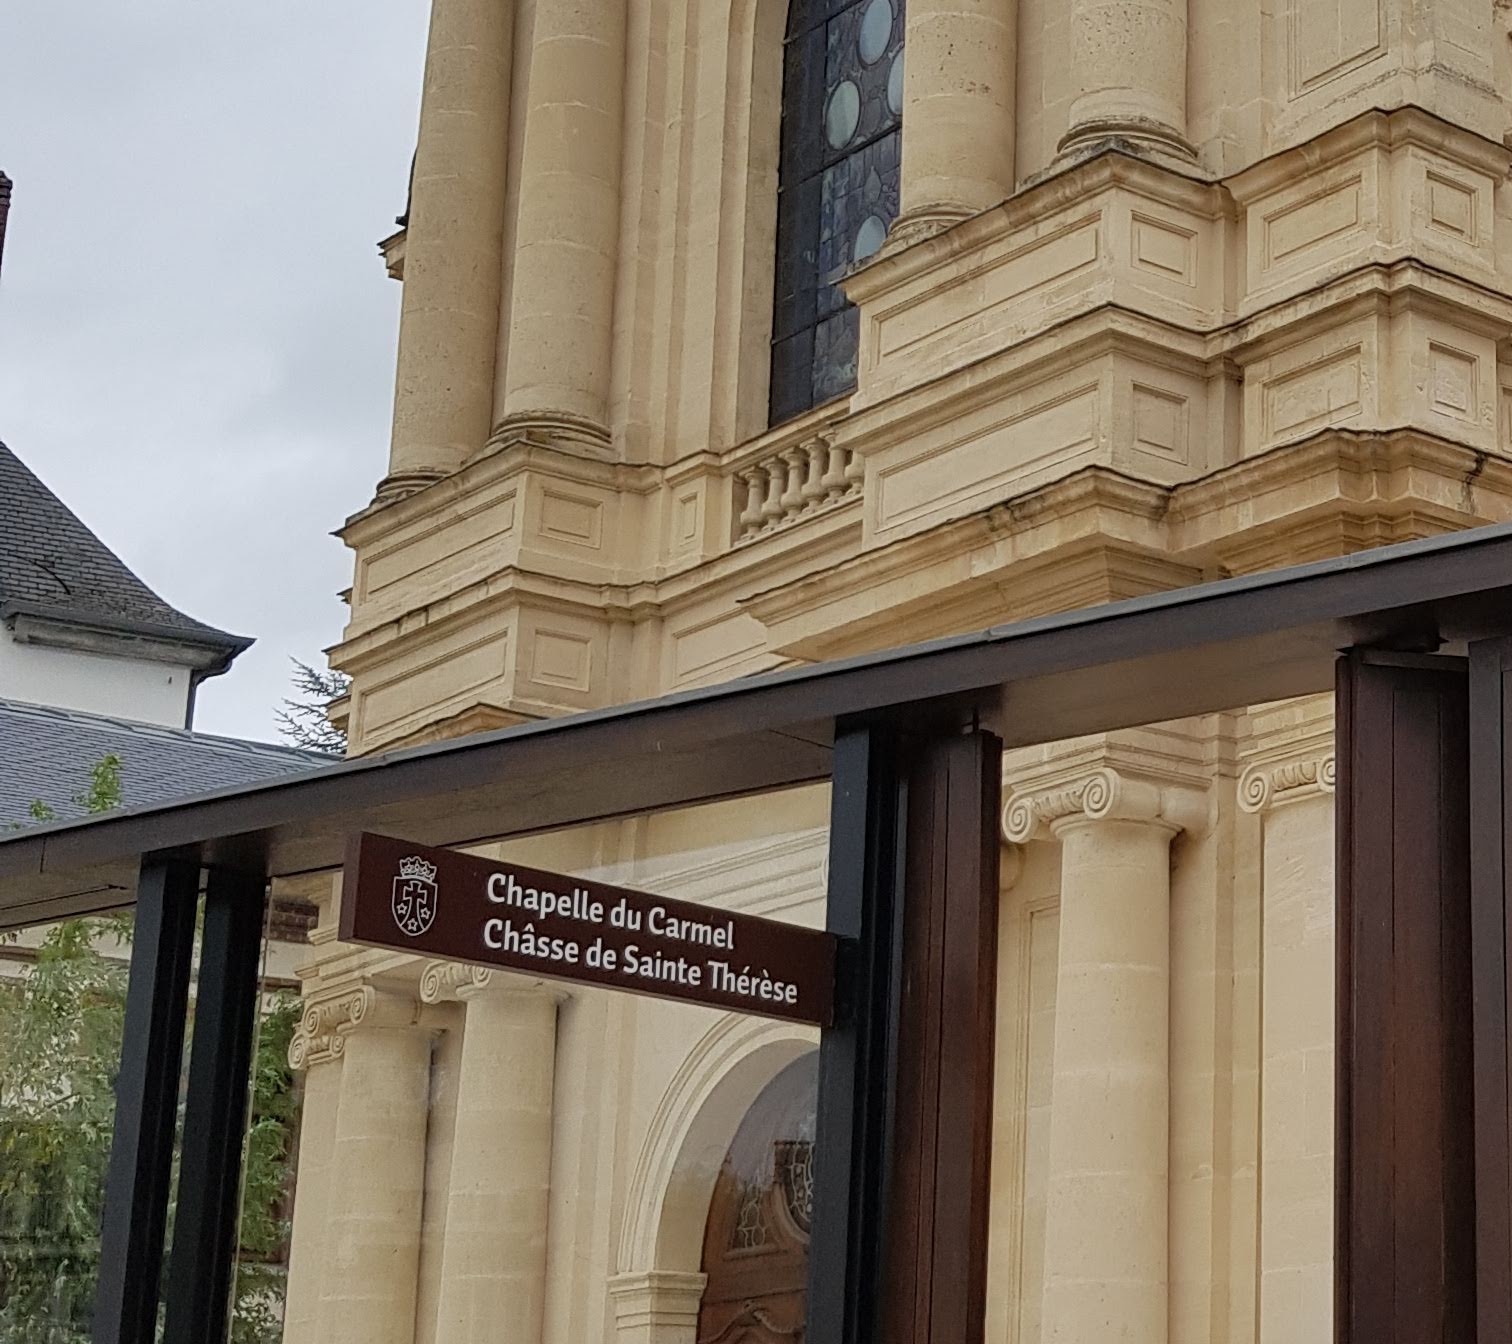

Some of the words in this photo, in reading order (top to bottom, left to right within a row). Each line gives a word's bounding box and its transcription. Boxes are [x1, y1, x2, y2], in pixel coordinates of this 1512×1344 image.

[487, 872, 604, 923] Chapelle
[610, 898, 642, 931] du
[648, 907, 734, 950] Carmel
[484, 918, 579, 963] Châsse
[586, 937, 617, 970] de
[623, 945, 701, 986] Sainte
[707, 960, 798, 1003] Thérèse
